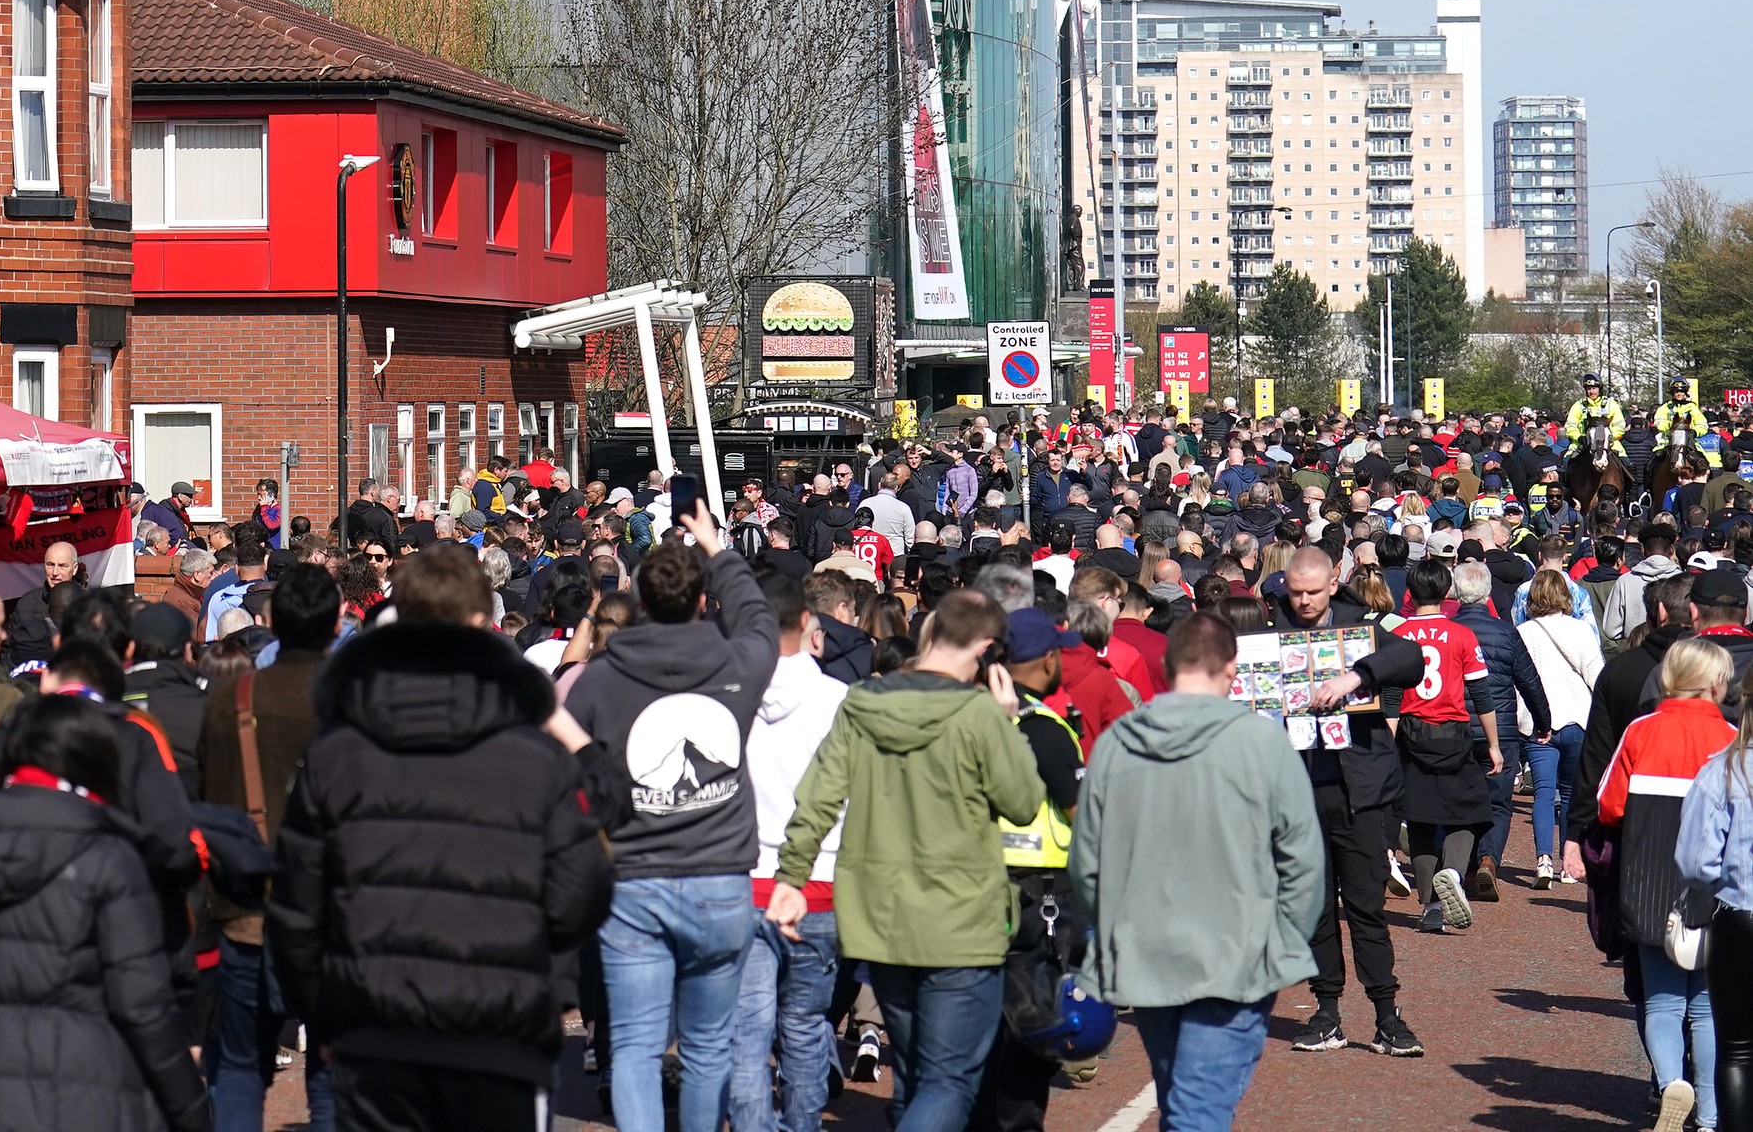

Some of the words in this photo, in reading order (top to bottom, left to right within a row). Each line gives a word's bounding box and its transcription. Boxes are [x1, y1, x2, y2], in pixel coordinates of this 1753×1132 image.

[992, 325, 1044, 334] Controlled
[763, 335, 854, 357] BURGER
[999, 337, 1037, 347] ZONE
[1164, 371, 1176, 379] W1
[1178, 371, 1191, 379] W2
[9, 537, 36, 552] IAN
[40, 525, 107, 548] STIRLING
[1402, 627, 1449, 644] MATA
